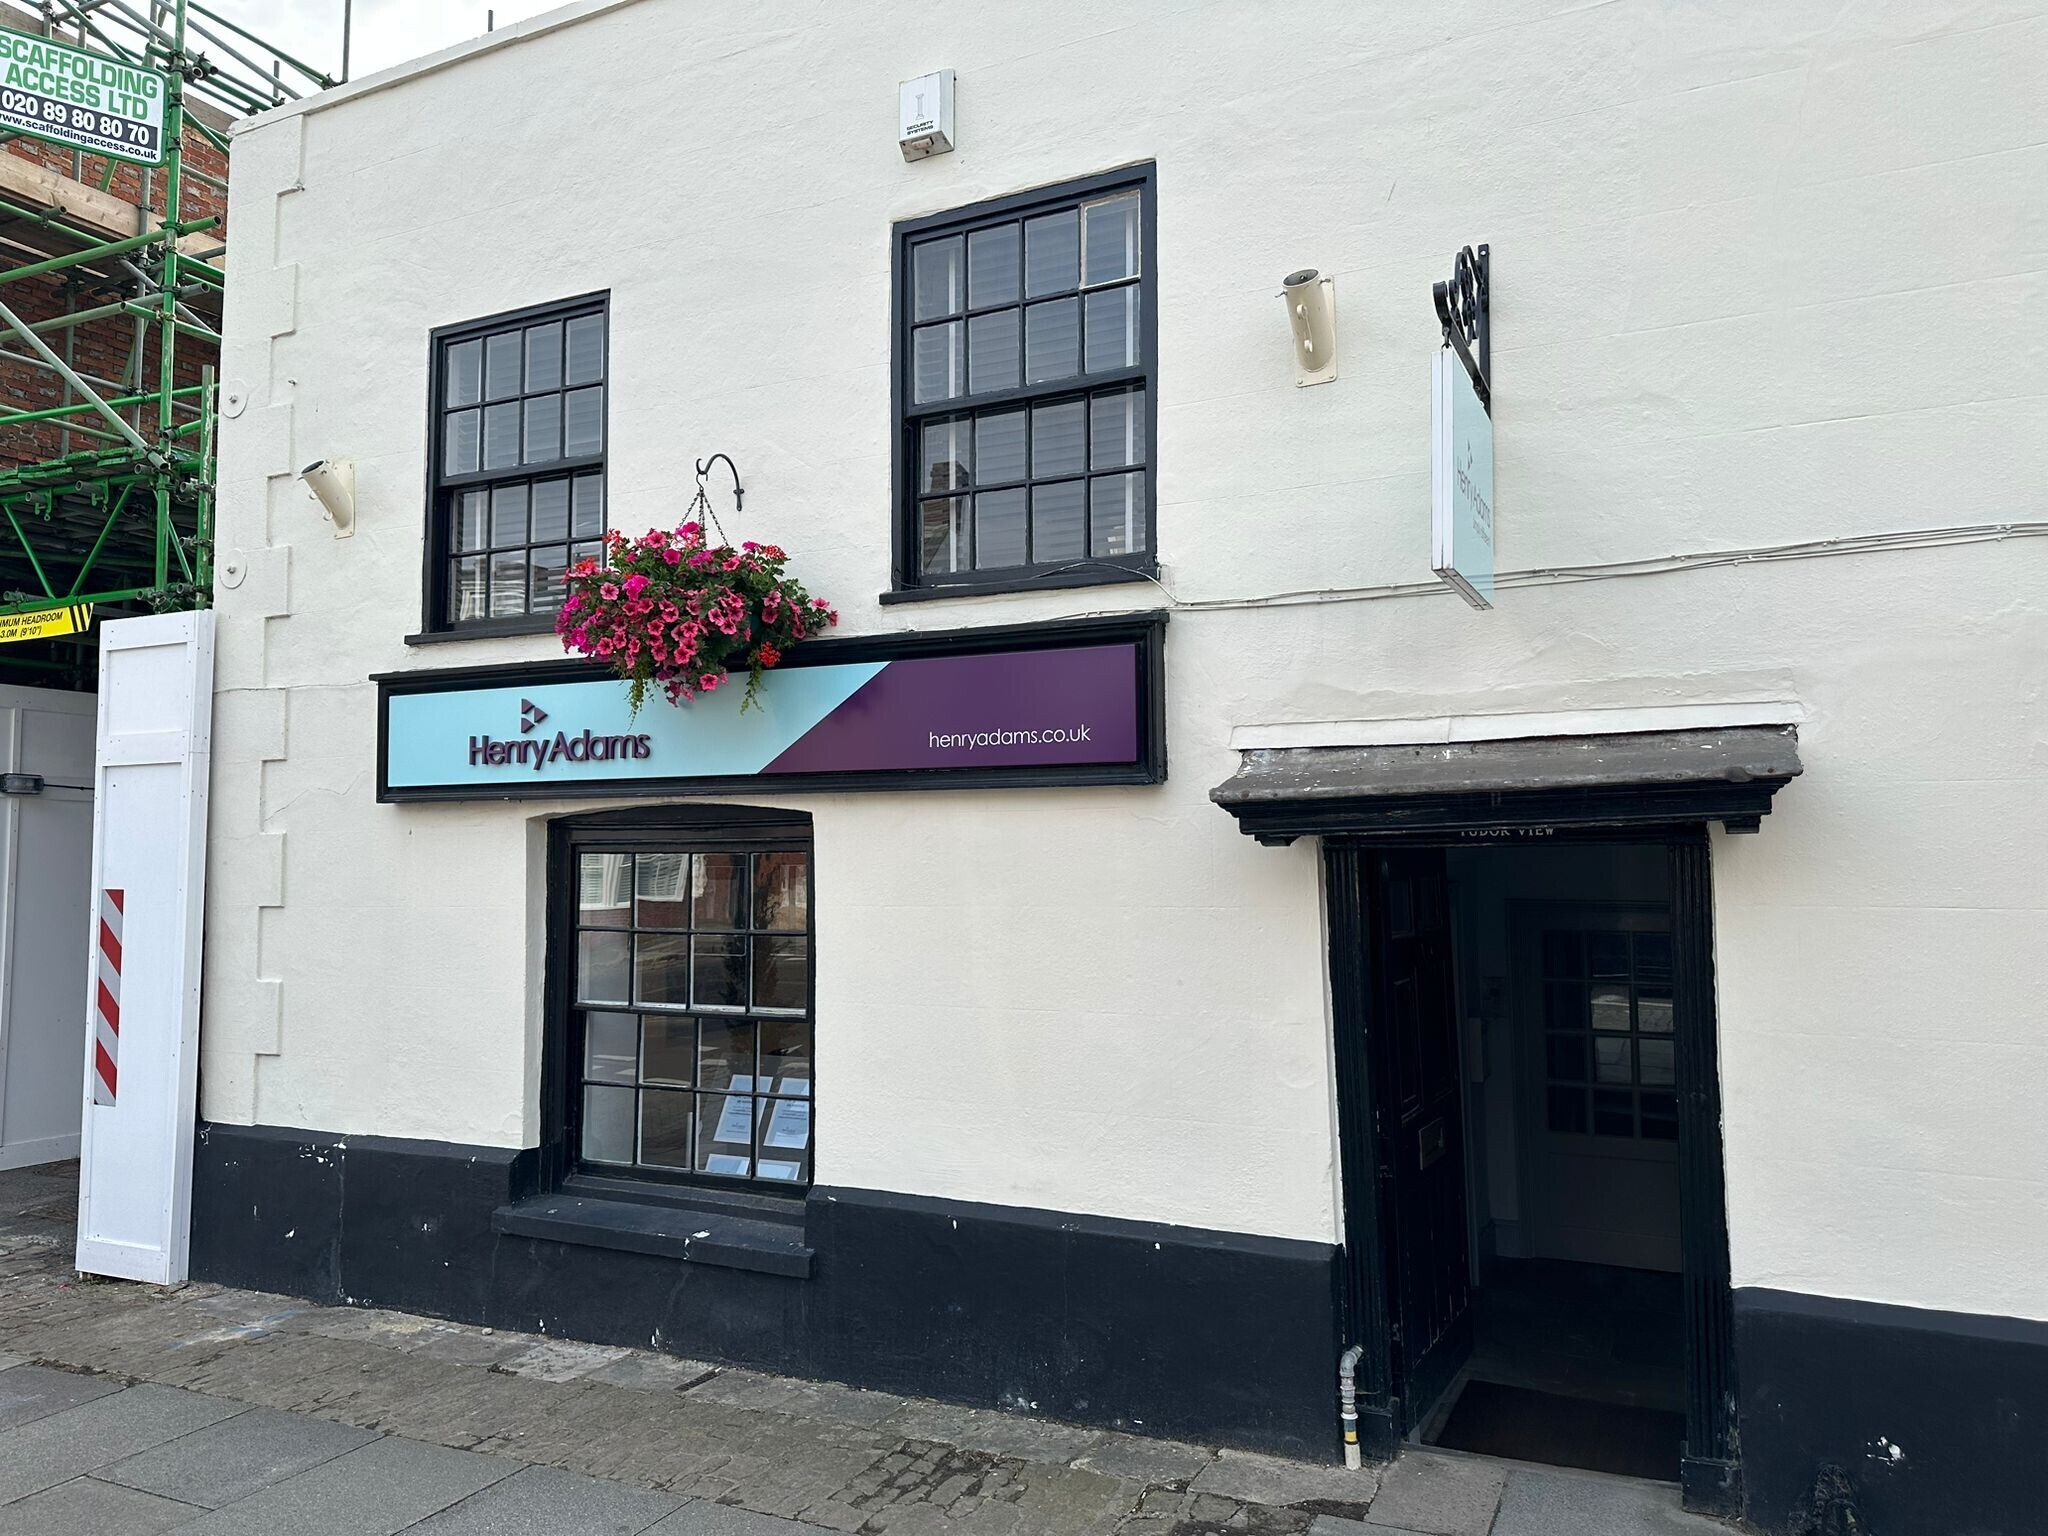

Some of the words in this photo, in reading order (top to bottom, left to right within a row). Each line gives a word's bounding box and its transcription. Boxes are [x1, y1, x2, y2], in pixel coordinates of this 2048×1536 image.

[0, 36, 158, 99] SCAFFOLDING
[5, 63, 101, 108] ACCESS
[108, 90, 148, 120] LTD
[0, 112, 157, 160] ww.scaffoldingaccess.co.uk
[2, 90, 38, 116] 020
[43, 101, 67, 124] 89
[71, 112, 95, 131] 80
[99, 117, 123, 138] 80
[127, 123, 150, 145] 70
[906, 120, 934, 131] SECURITY
[906, 125, 934, 136] SYSTEMS
[21, 611, 63, 626] HEADROOM
[929, 724, 1091, 750] henryadams.co.uk
